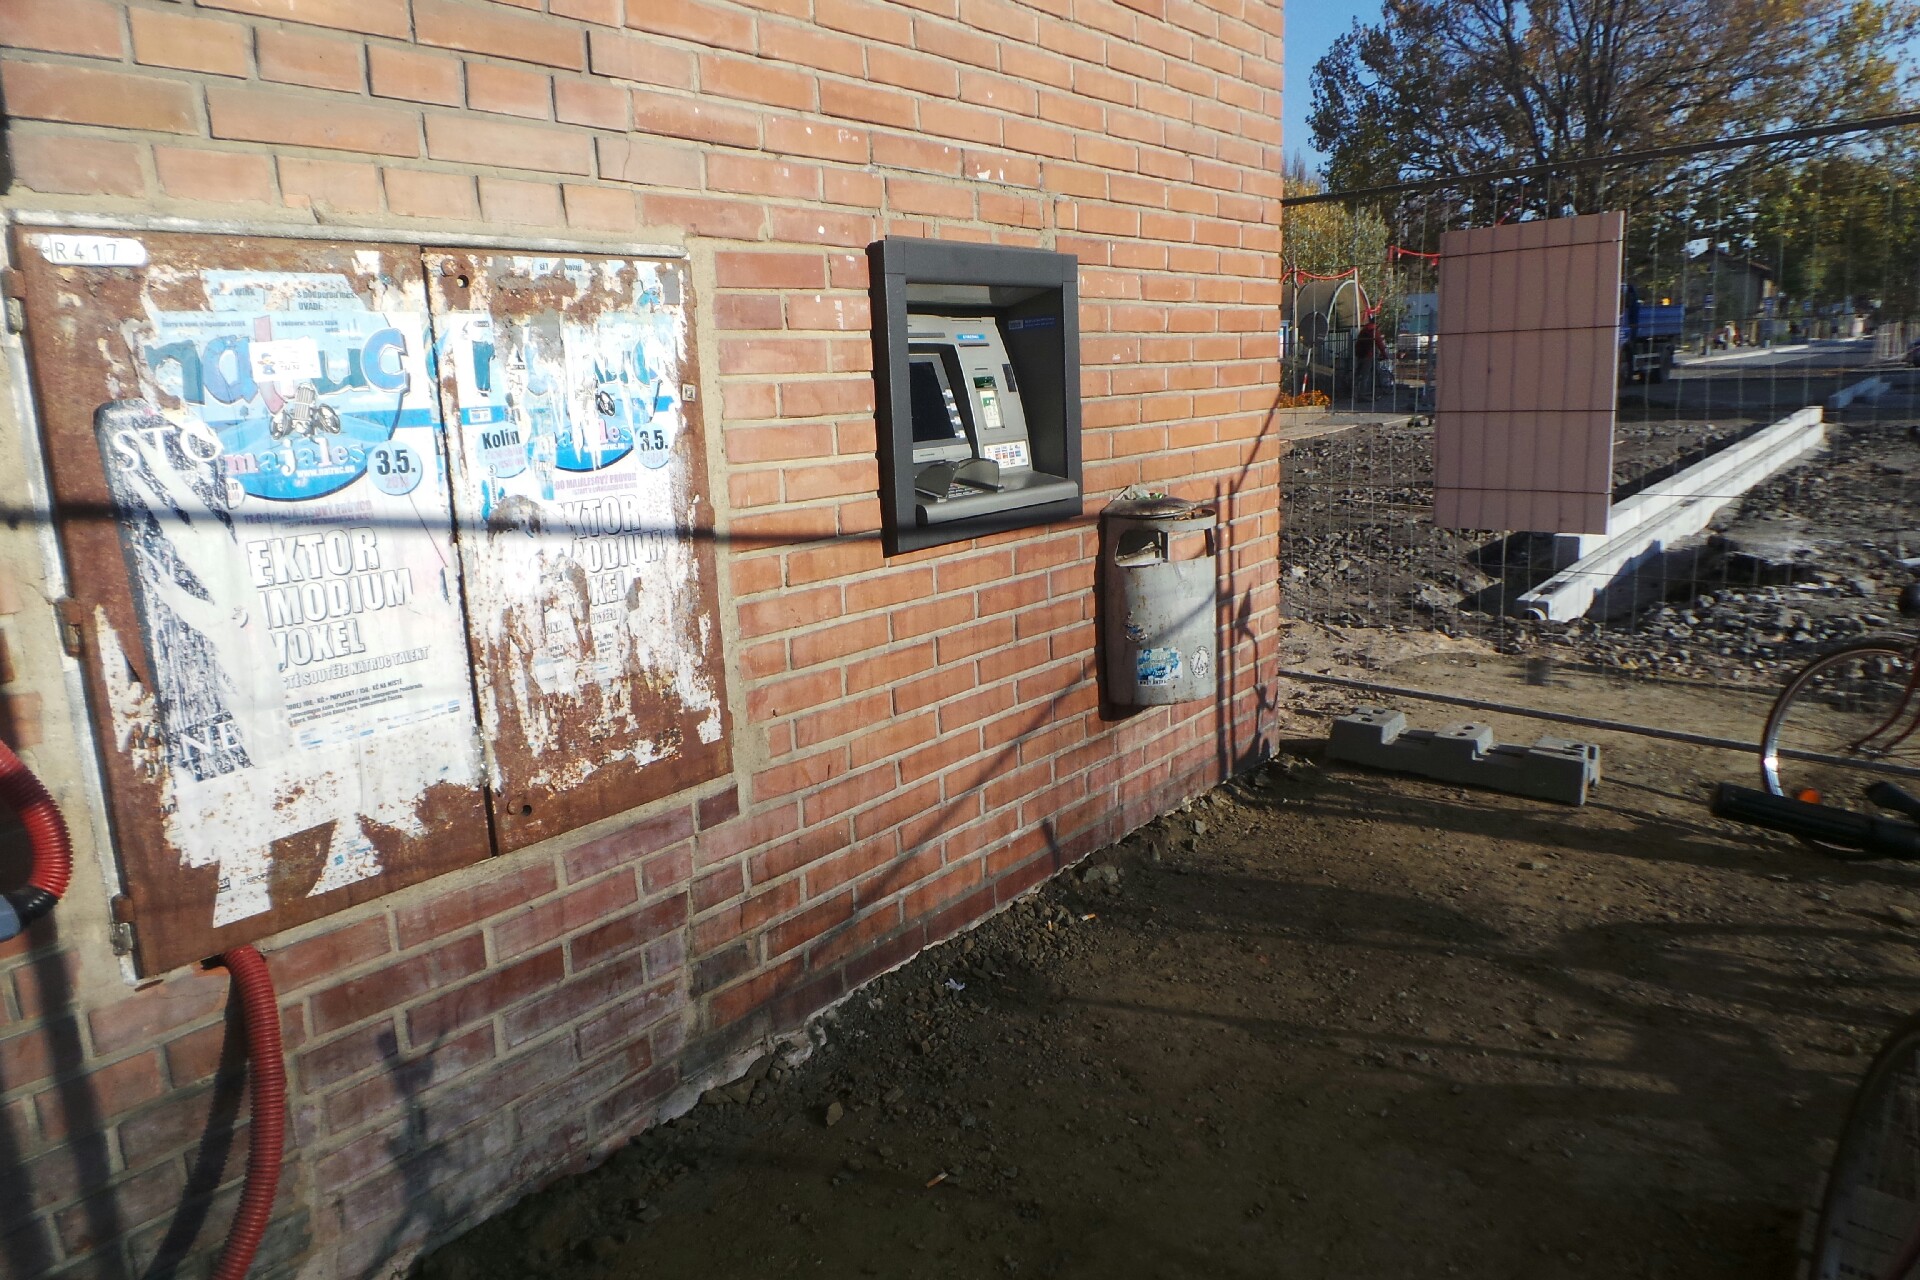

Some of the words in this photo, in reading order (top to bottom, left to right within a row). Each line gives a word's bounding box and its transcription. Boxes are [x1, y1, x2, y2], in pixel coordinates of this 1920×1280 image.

[639, 429, 669, 452] 3.5.
[375, 449, 416, 476] 3.5.
[246, 527, 381, 588] EKTOR
[350, 654, 393, 676] NATRUC
[392, 646, 430, 666] TALENT
